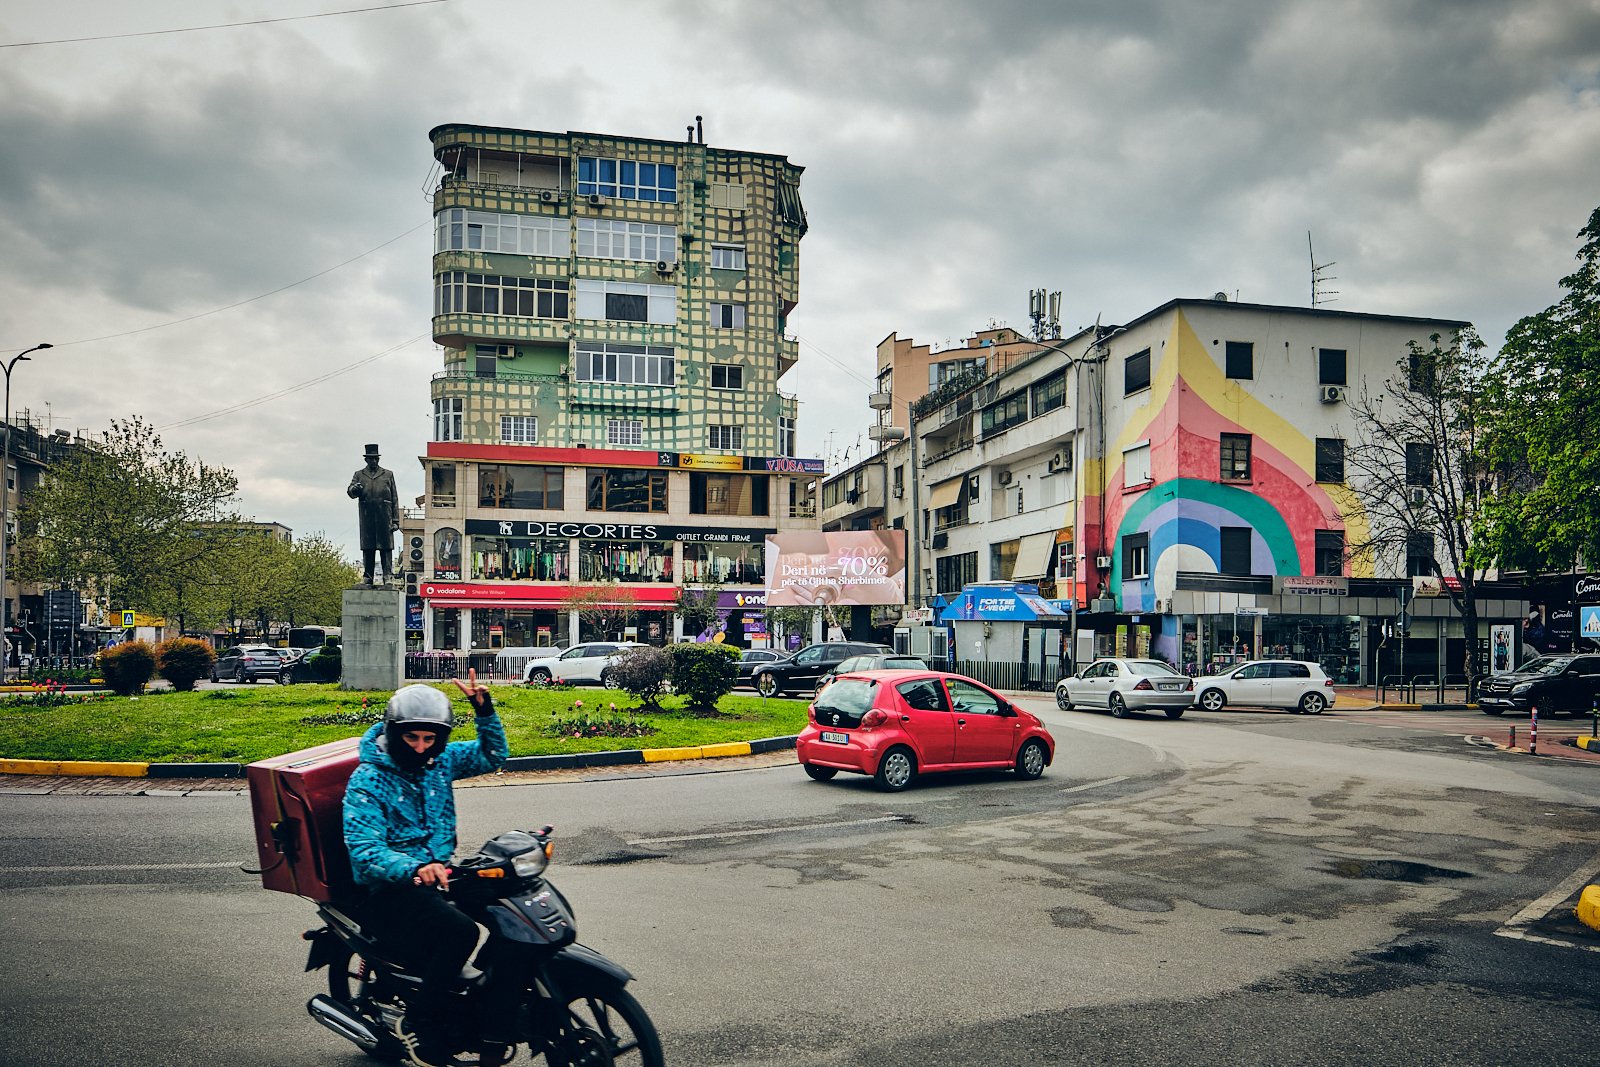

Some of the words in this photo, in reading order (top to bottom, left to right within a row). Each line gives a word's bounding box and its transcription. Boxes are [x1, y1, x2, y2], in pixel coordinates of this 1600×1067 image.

[766, 458, 805, 472] VJOSA
[527, 522, 657, 539] DEGORTES
[676, 533, 701, 541] OUTLET
[703, 533, 728, 541] GRANDI
[731, 534, 751, 542] FIRME
[781, 564, 808, 576] Deri
[811, 564, 827, 576] në
[781, 578, 797, 587] për
[798, 577, 808, 585] të
[809, 577, 837, 587] Gjitha
[838, 576, 887, 585] Shërbimet
[1289, 587, 1346, 596] TEMPUS
[745, 595, 765, 605] one
